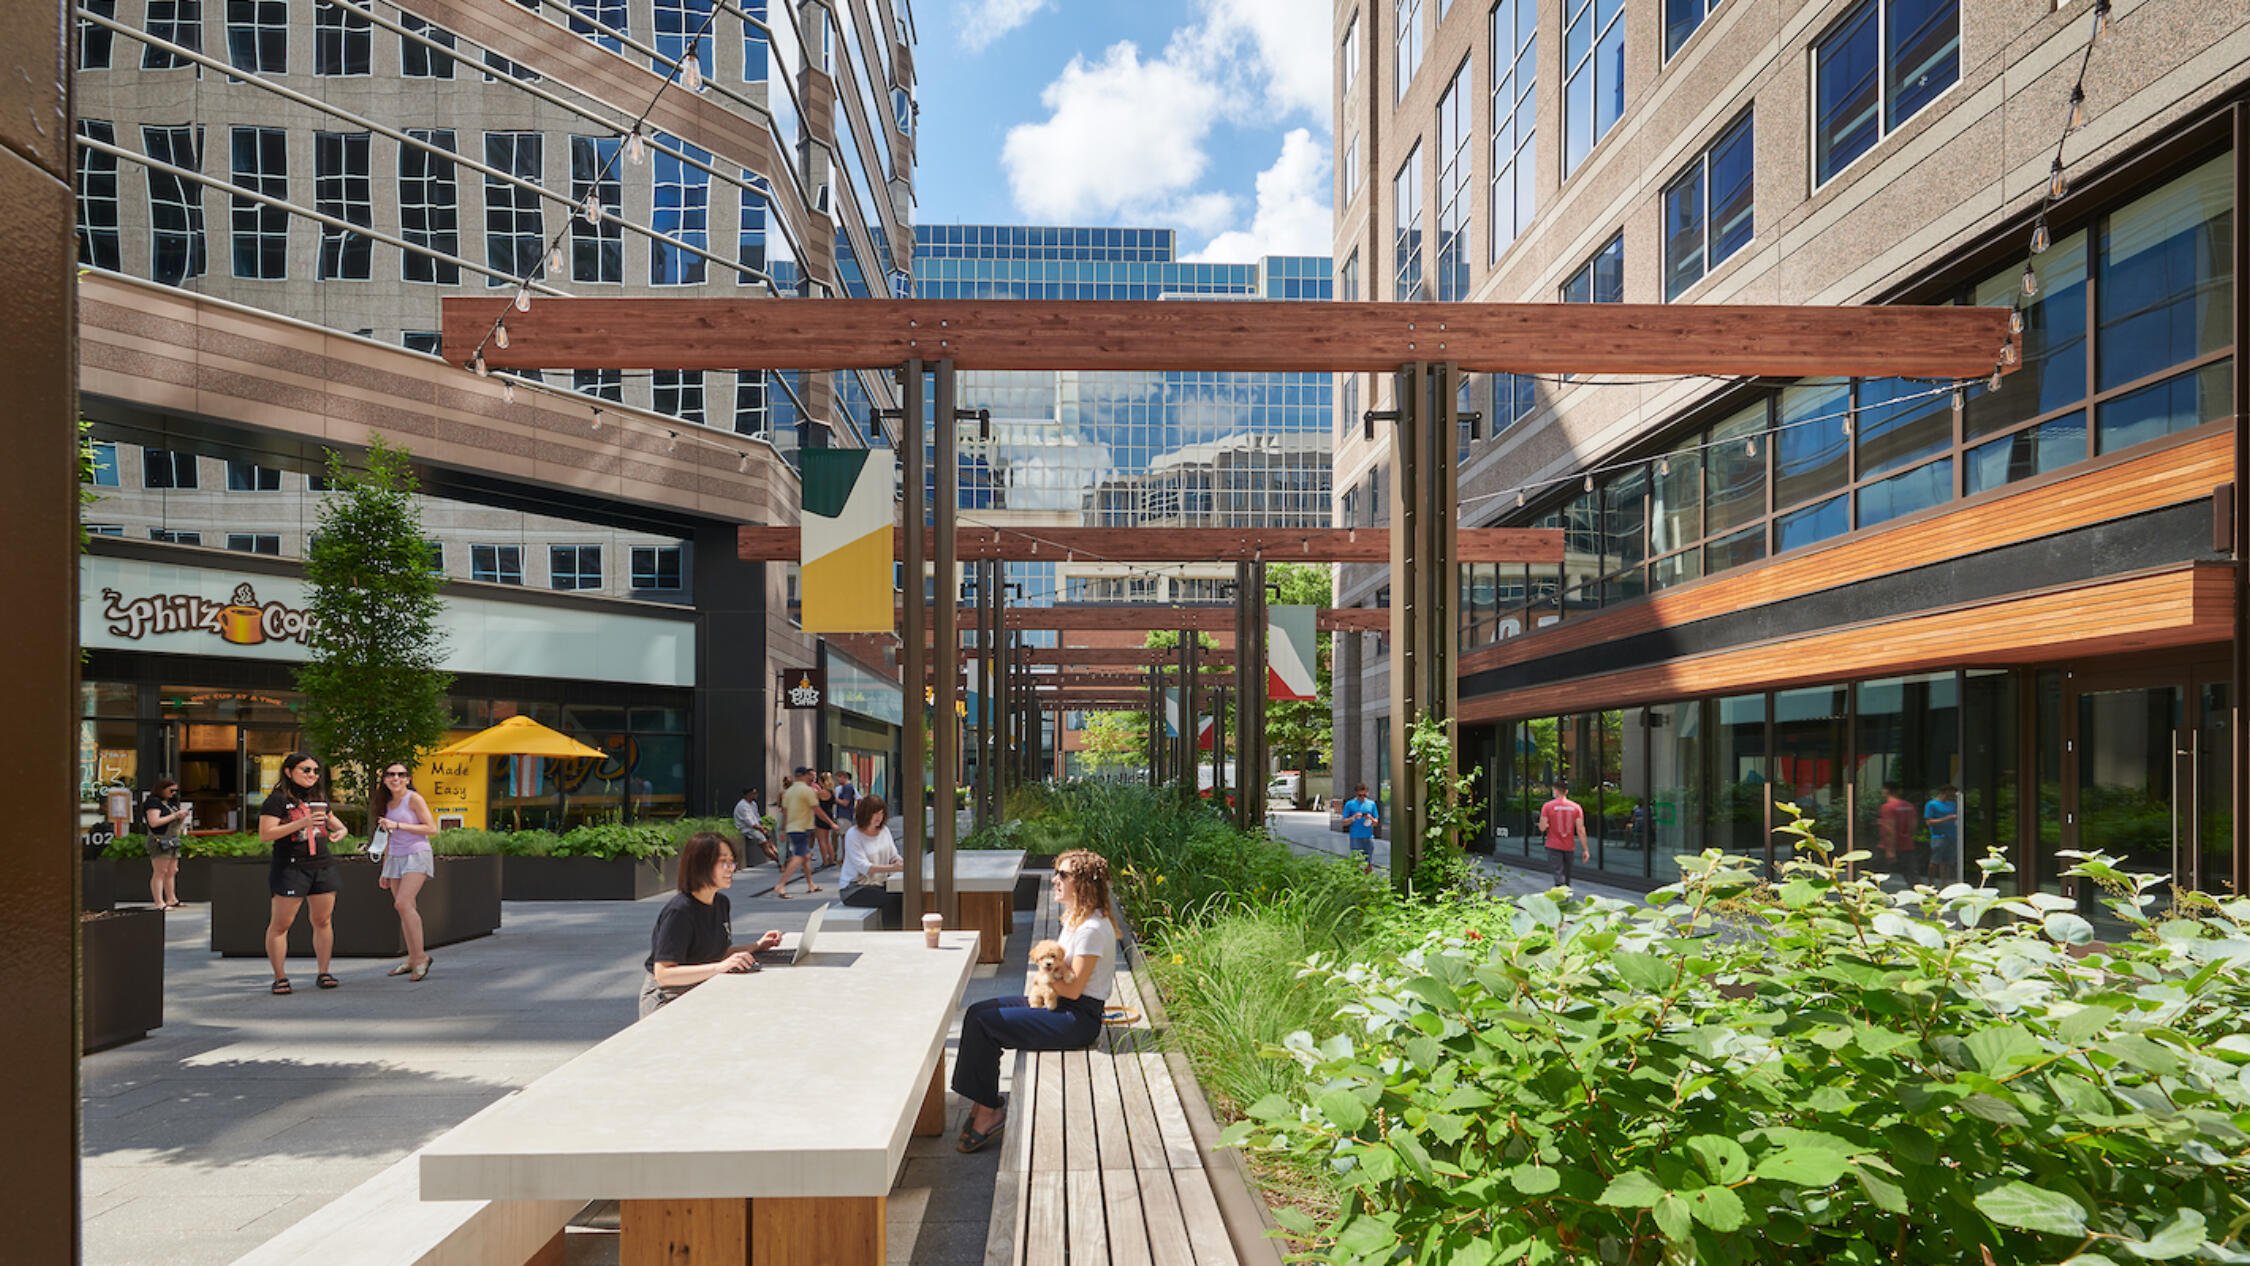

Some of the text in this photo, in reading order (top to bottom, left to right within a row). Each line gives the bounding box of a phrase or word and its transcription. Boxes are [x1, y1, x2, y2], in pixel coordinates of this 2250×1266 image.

[102, 587, 223, 640] Philz
[431, 761, 469, 776] Made
[434, 781, 467, 800] Easy
